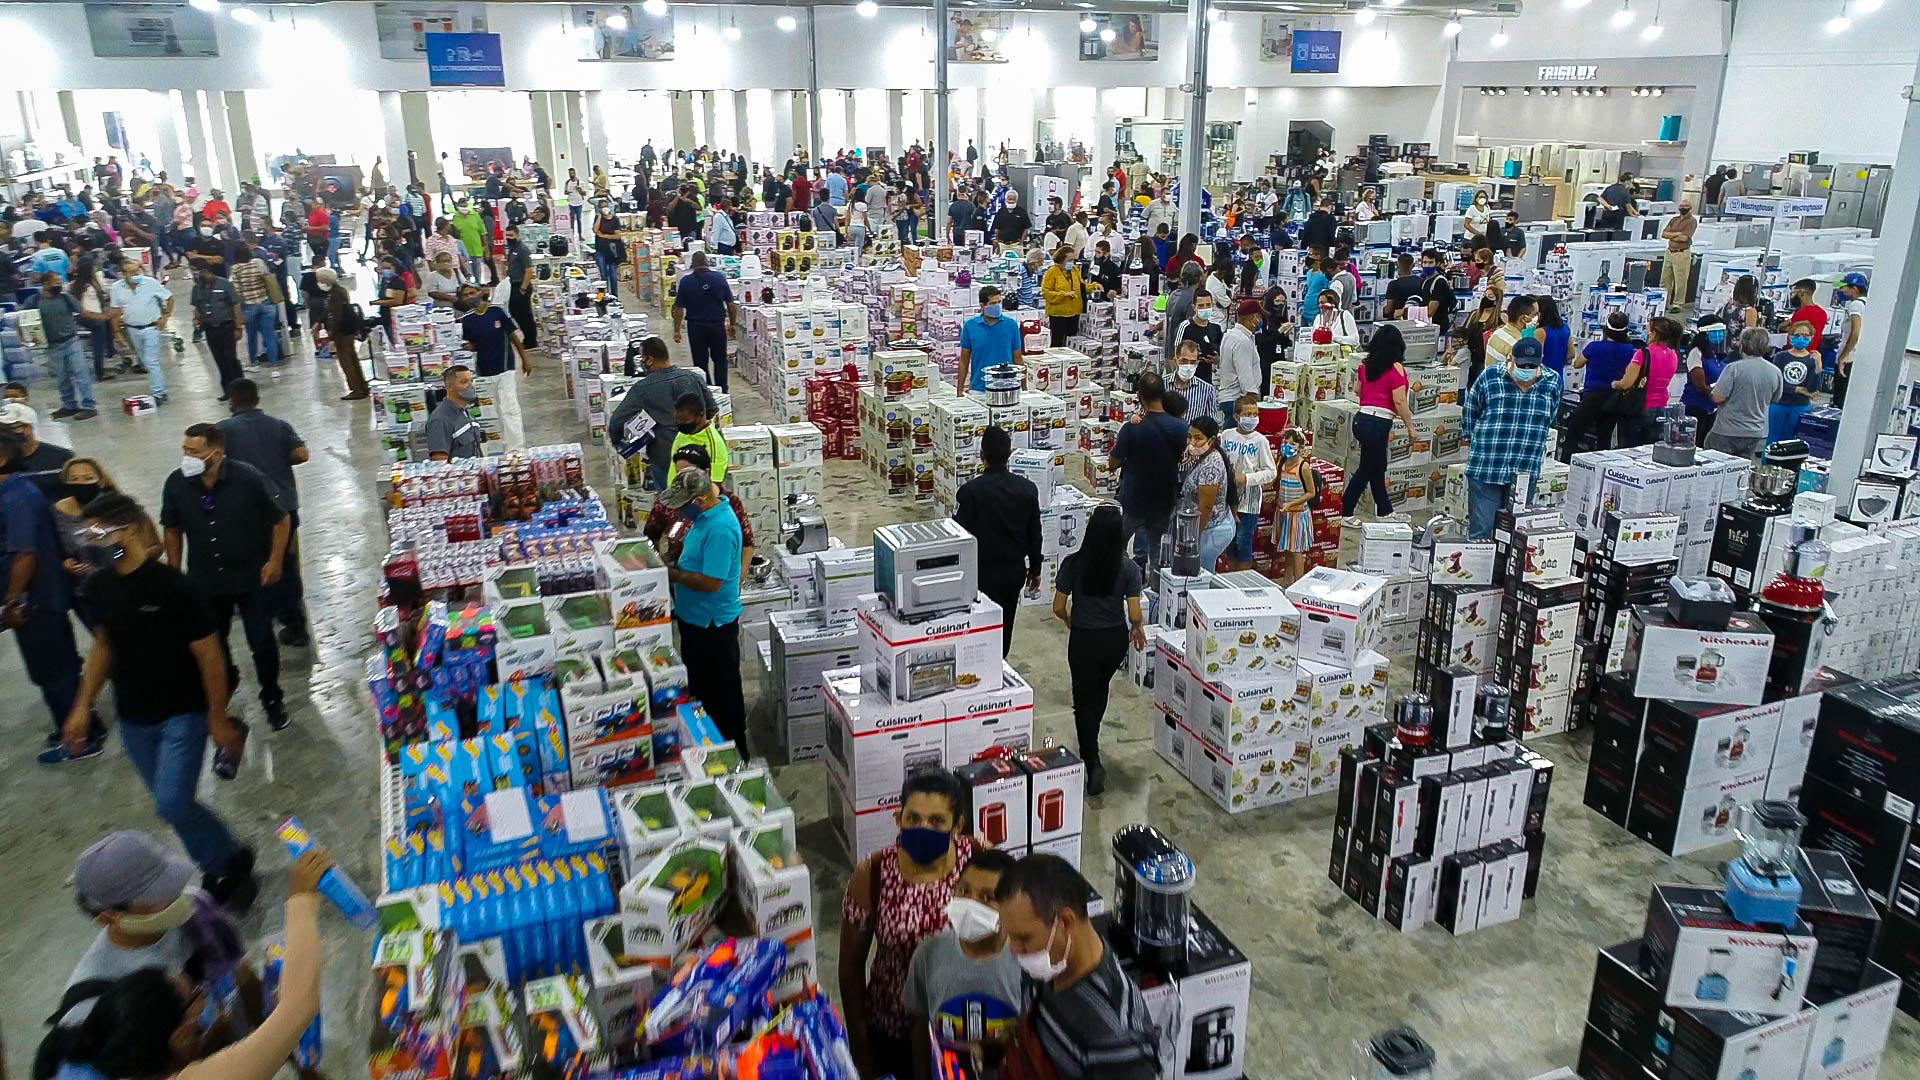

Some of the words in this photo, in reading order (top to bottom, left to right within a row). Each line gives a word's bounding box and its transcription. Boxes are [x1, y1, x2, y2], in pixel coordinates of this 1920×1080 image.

[1538, 65, 1598, 80] FRIGILUX
[1740, 202, 1774, 212] Westinghouse
[1224, 440, 1238, 450] NEW
[1238, 444, 1258, 456] YORK
[1572, 460, 1596, 472] Cuisinart
[1726, 465, 1749, 473] Cuisinart
[1608, 469, 1640, 484] Cuisinart
[1674, 472, 1698, 480] Cuisinart
[1701, 469, 1724, 477] Cuisinart
[1646, 477, 1668, 485] Cuisinart
[1302, 598, 1340, 611] Cuisinart
[926, 620, 970, 635] Cuisinart
[1214, 620, 1253, 628] Cuisinart
[1700, 636, 1769, 647] KitchenAid
[1319, 671, 1352, 684] Cuisinart
[1238, 686, 1273, 698] Cuisinart
[968, 699, 1012, 714] Cuisinart
[876, 713, 923, 728] Cuisinart
[1318, 732, 1350, 744] Cuisinart
[1239, 748, 1273, 761] Cuisinart
